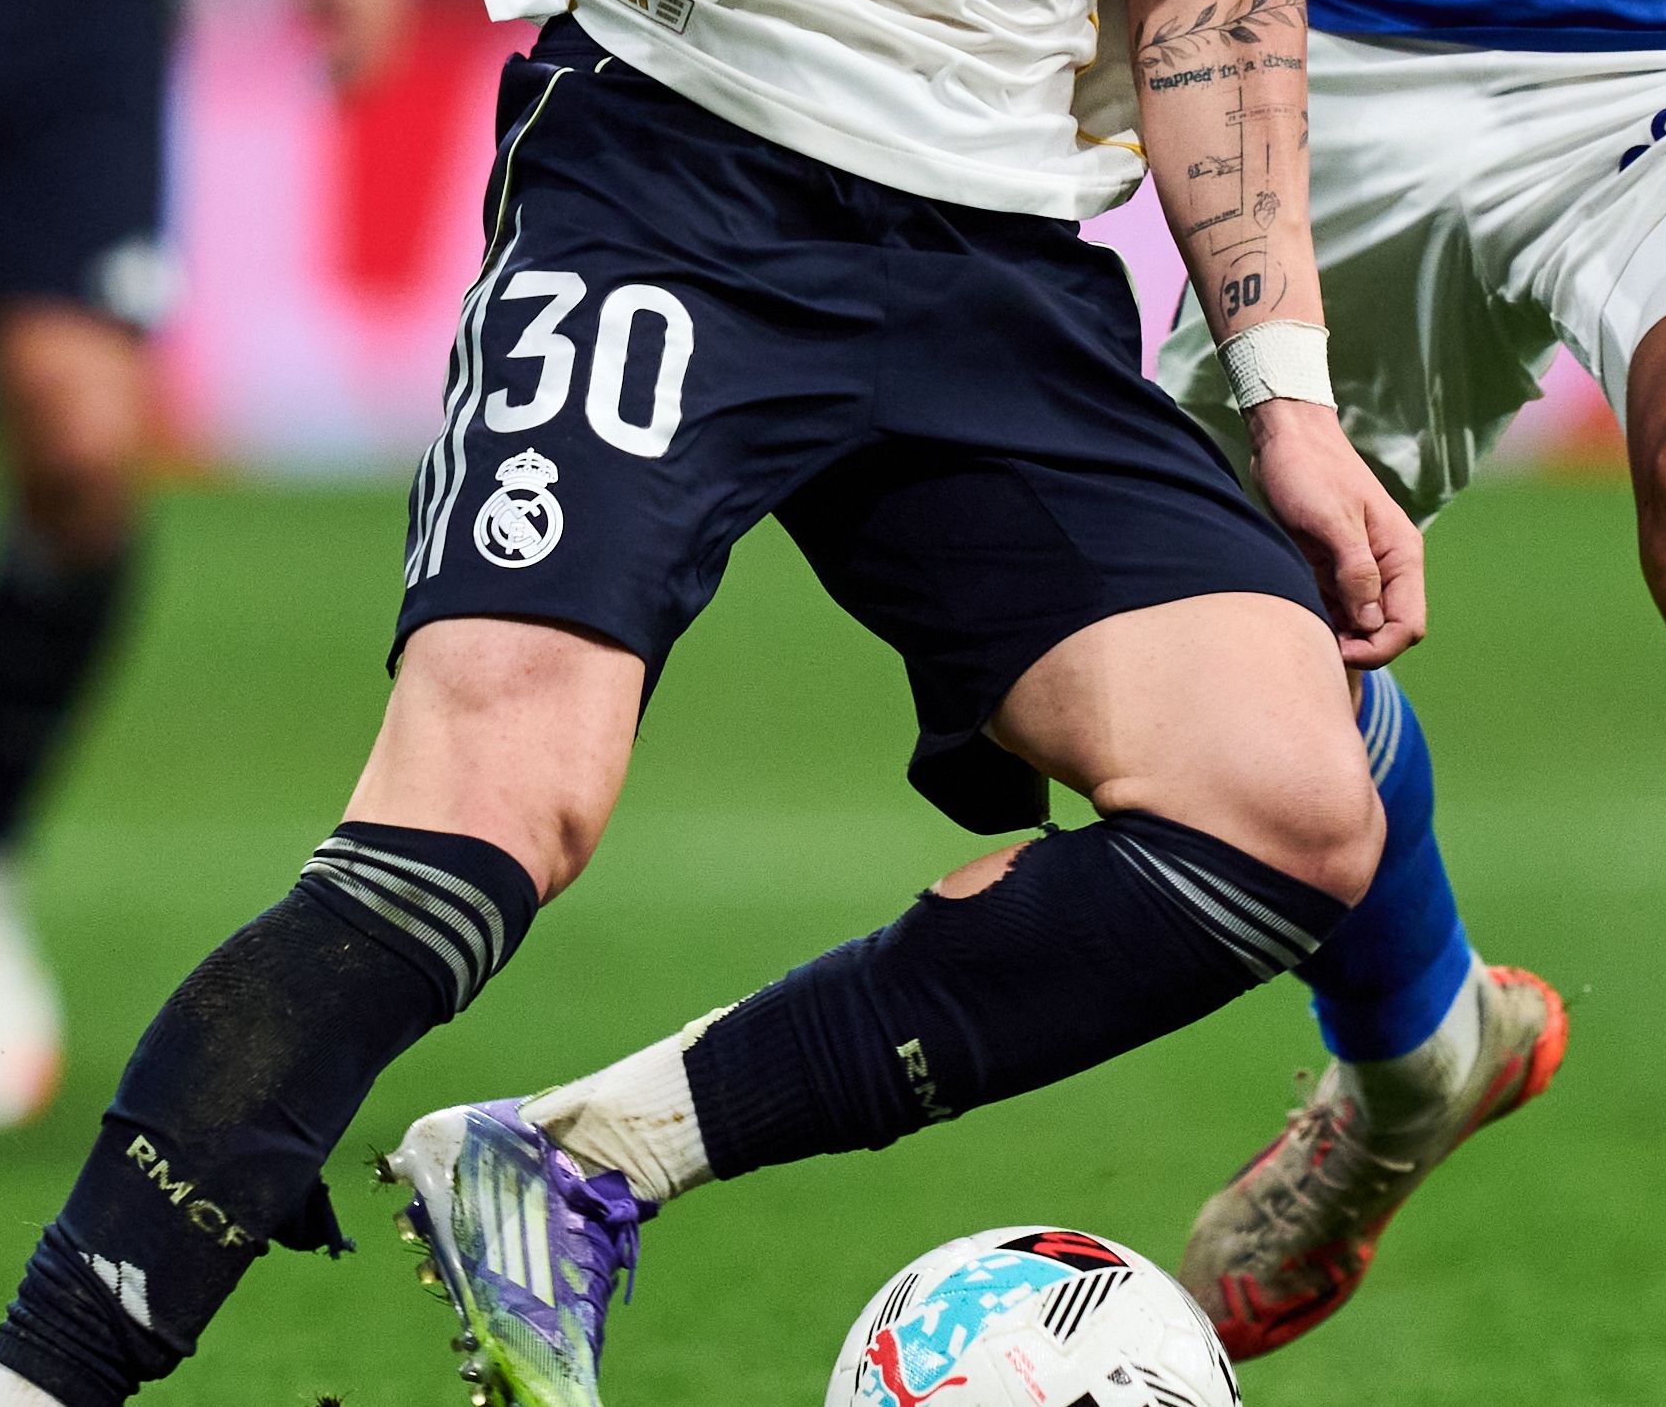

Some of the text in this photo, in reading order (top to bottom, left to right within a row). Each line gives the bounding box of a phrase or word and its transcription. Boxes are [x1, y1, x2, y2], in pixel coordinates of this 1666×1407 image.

[1149, 67, 1214, 91] trapped
[1224, 273, 1261, 318] 30
[484, 270, 694, 458] 30
[125, 1134, 255, 1247] RMCF
